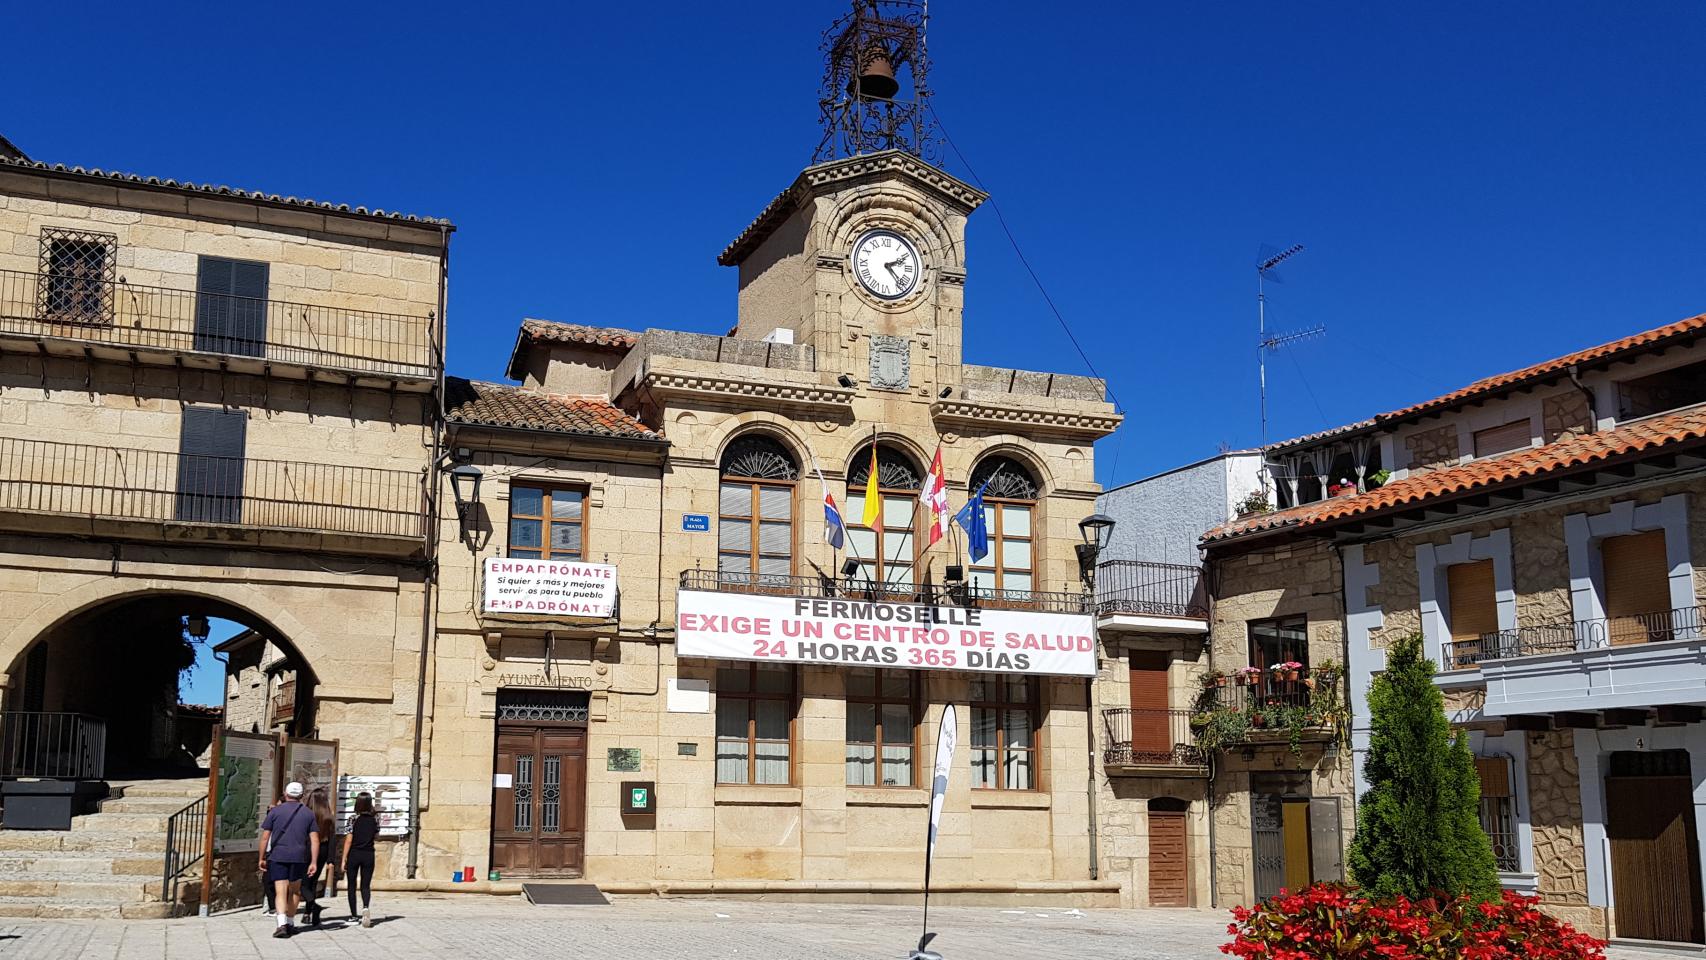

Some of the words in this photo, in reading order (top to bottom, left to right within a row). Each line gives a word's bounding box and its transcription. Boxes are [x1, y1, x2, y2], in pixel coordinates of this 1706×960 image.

[497, 576, 506, 584] Si
[507, 577, 541, 586] quiers
[562, 580, 569, 588] y
[570, 580, 605, 589] mejores
[499, 586, 538, 595] servios
[573, 591, 604, 599] pueblo
[795, 599, 982, 627] FERMOSELLE
[680, 613, 771, 636] EXIGE
[782, 620, 823, 639] UN
[833, 622, 950, 646] CENTRO
[960, 630, 996, 648] DE
[1004, 632, 1093, 652] SALUD
[753, 639, 788, 658] 24
[798, 641, 898, 664] HORAS
[908, 647, 957, 667] 365
[966, 648, 1030, 670] DÍAS
[498, 673, 592, 688] AYUNTAMENTO
[1637, 738, 1643, 748] 4
